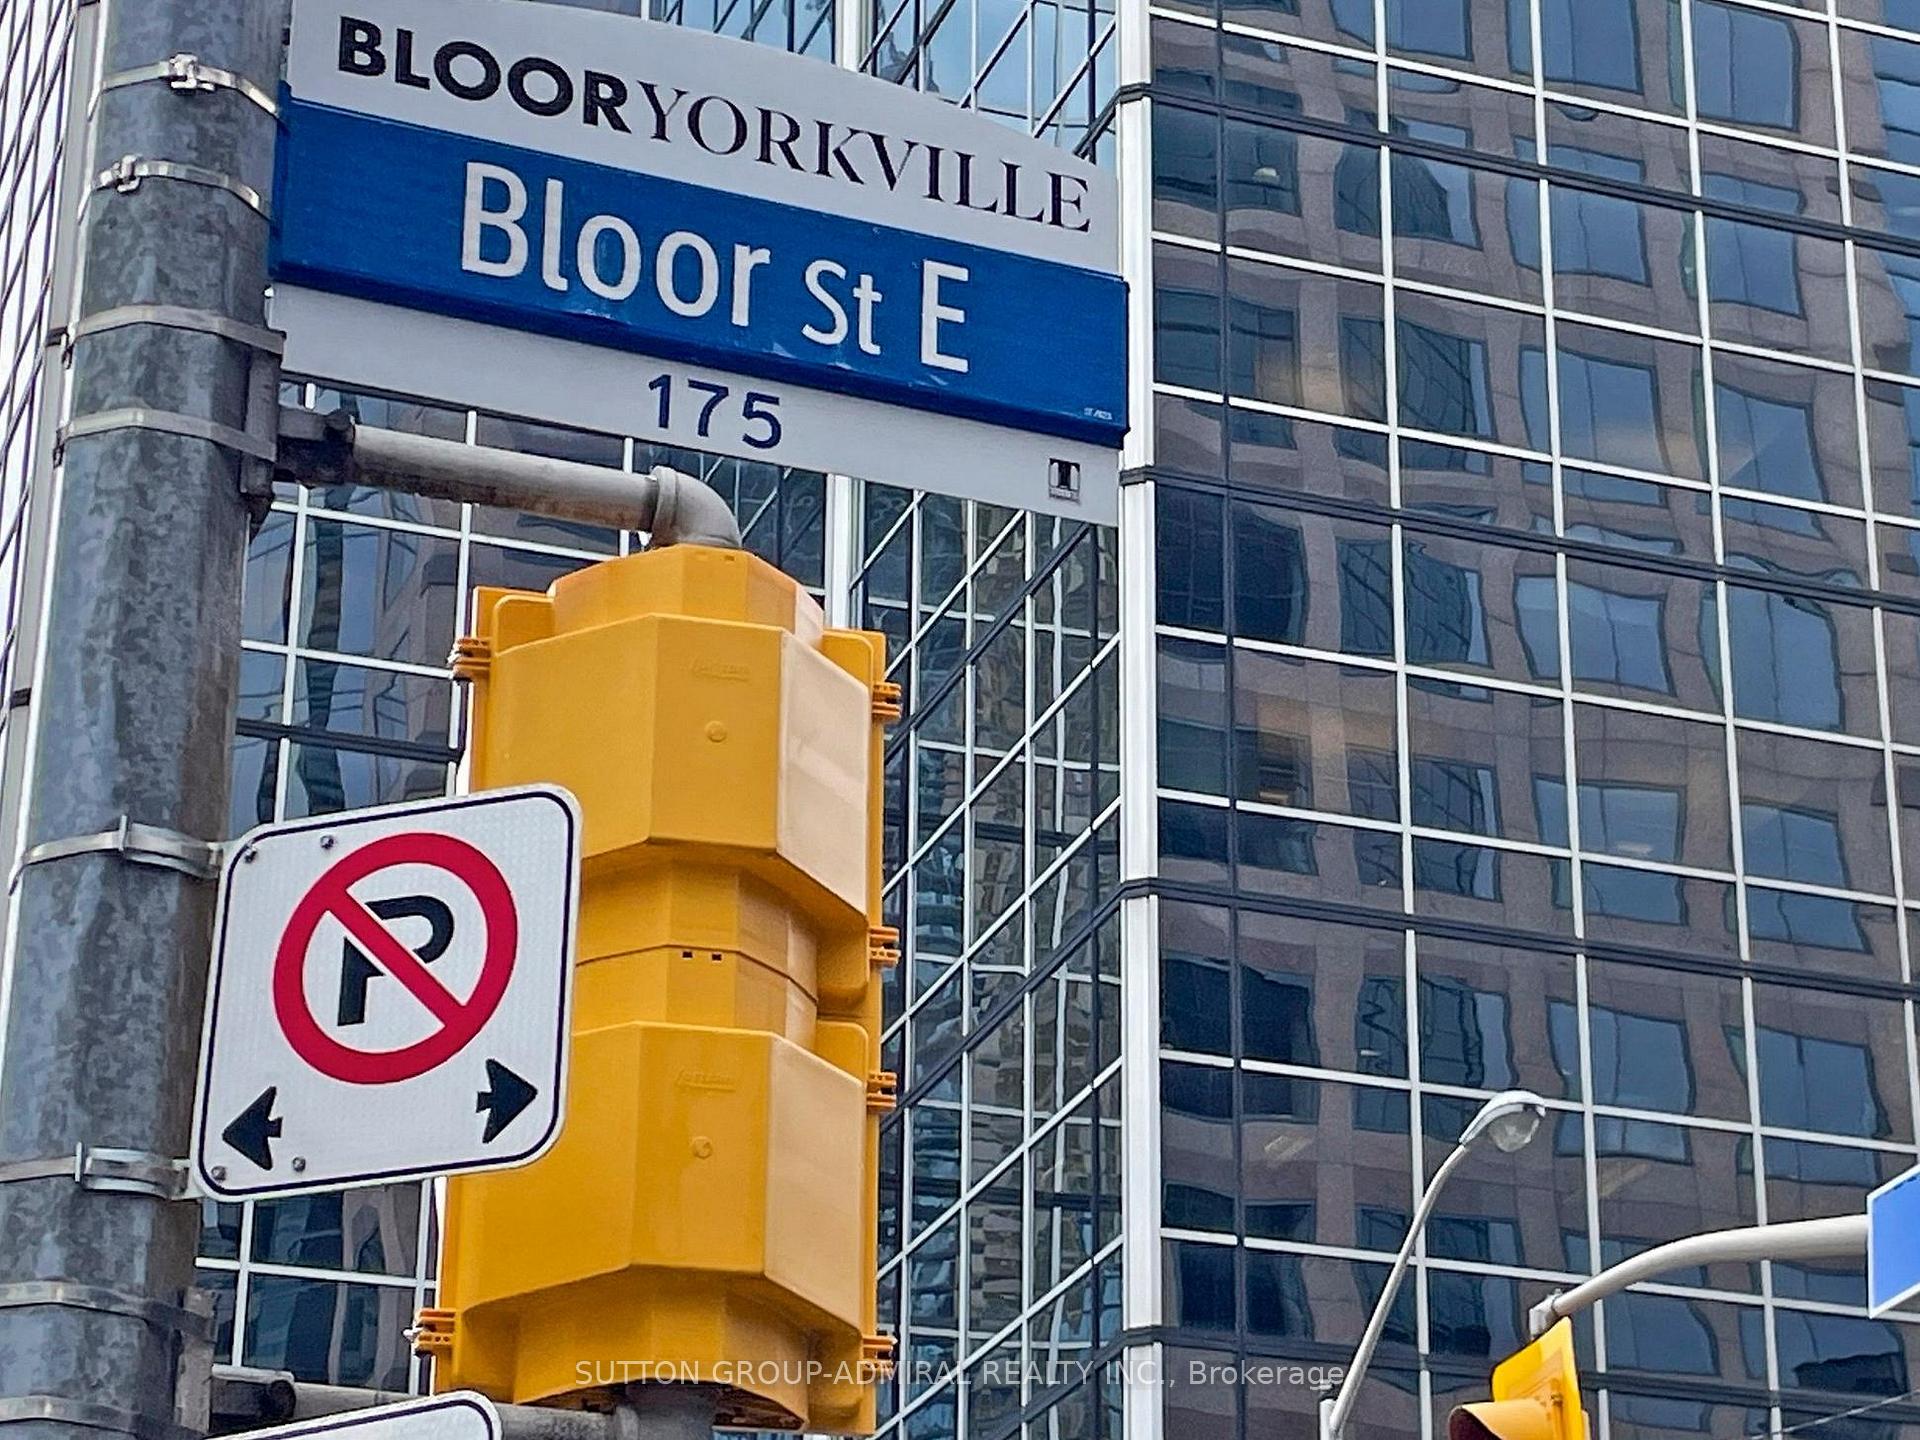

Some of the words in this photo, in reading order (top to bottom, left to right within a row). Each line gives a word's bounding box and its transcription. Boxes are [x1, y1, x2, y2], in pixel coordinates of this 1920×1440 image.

[460, 160, 771, 328] Bloor
[802, 259, 882, 355] St
[920, 257, 969, 373] E
[647, 373, 783, 450] 175
